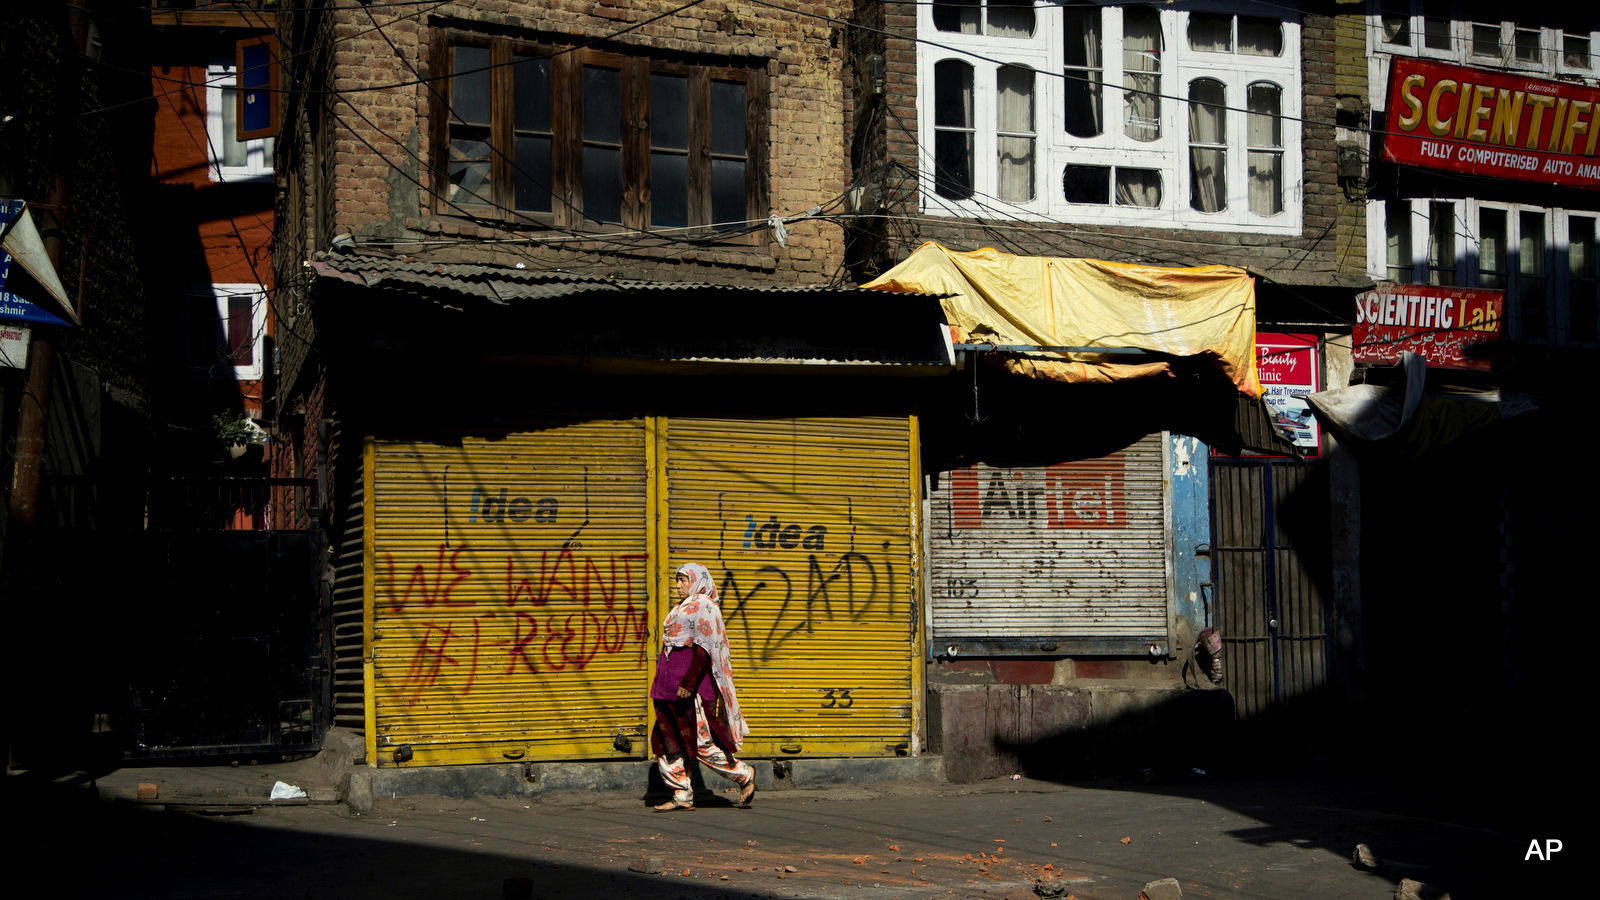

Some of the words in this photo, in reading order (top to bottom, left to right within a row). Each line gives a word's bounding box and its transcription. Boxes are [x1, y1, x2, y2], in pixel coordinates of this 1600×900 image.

[1420, 141, 1454, 160] FULLY
[1458, 147, 1538, 171] COMPUTERISED
[1543, 159, 1573, 176] AUTO
[1261, 347, 1297, 372] Beauty
[1256, 368, 1281, 381] linic
[1271, 387, 1282, 395] Hair
[384, 544, 476, 613] WE
[506, 547, 649, 609] WANT
[947, 579, 979, 598] 103
[821, 687, 853, 709] 33
